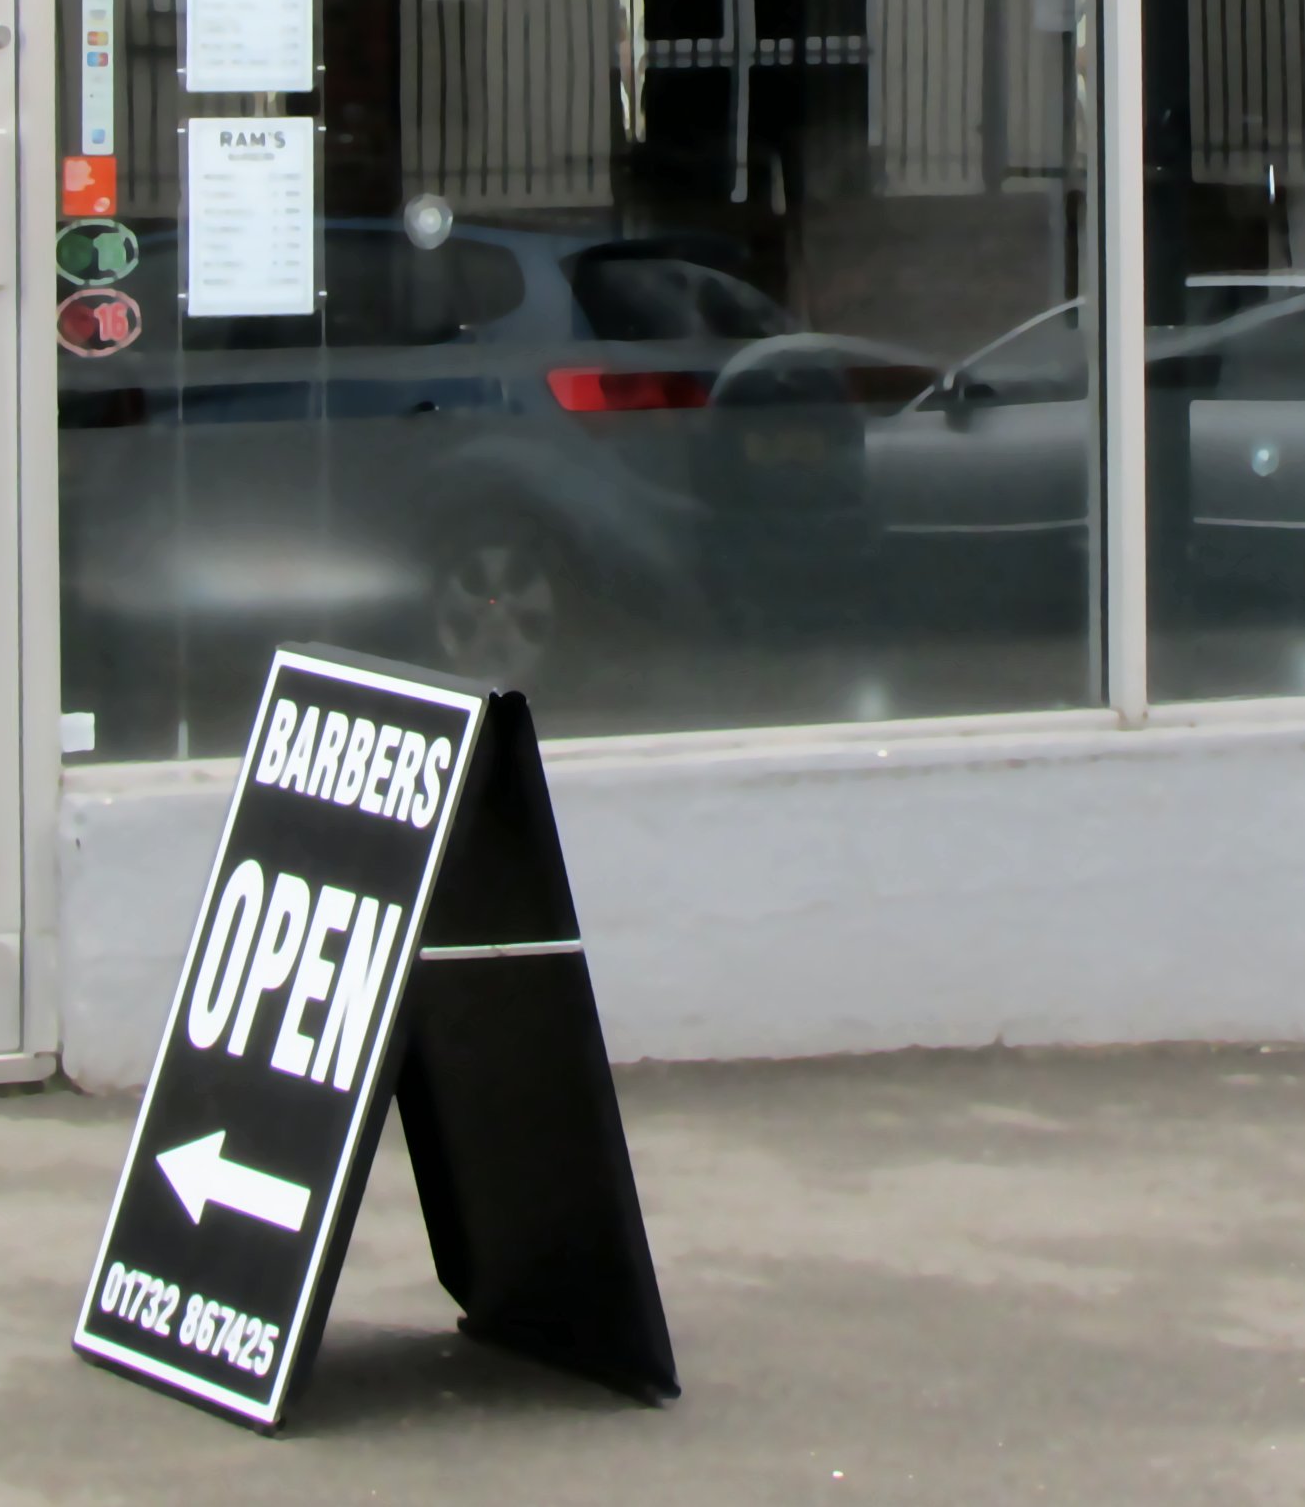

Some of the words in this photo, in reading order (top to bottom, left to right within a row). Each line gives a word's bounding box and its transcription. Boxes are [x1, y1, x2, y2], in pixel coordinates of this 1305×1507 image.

[219, 131, 287, 149] RAM'S
[254, 697, 452, 829] BARBERS
[187, 858, 403, 1092] OPEN
[100, 1260, 181, 1336] 01732
[178, 1293, 280, 1378] 867425
